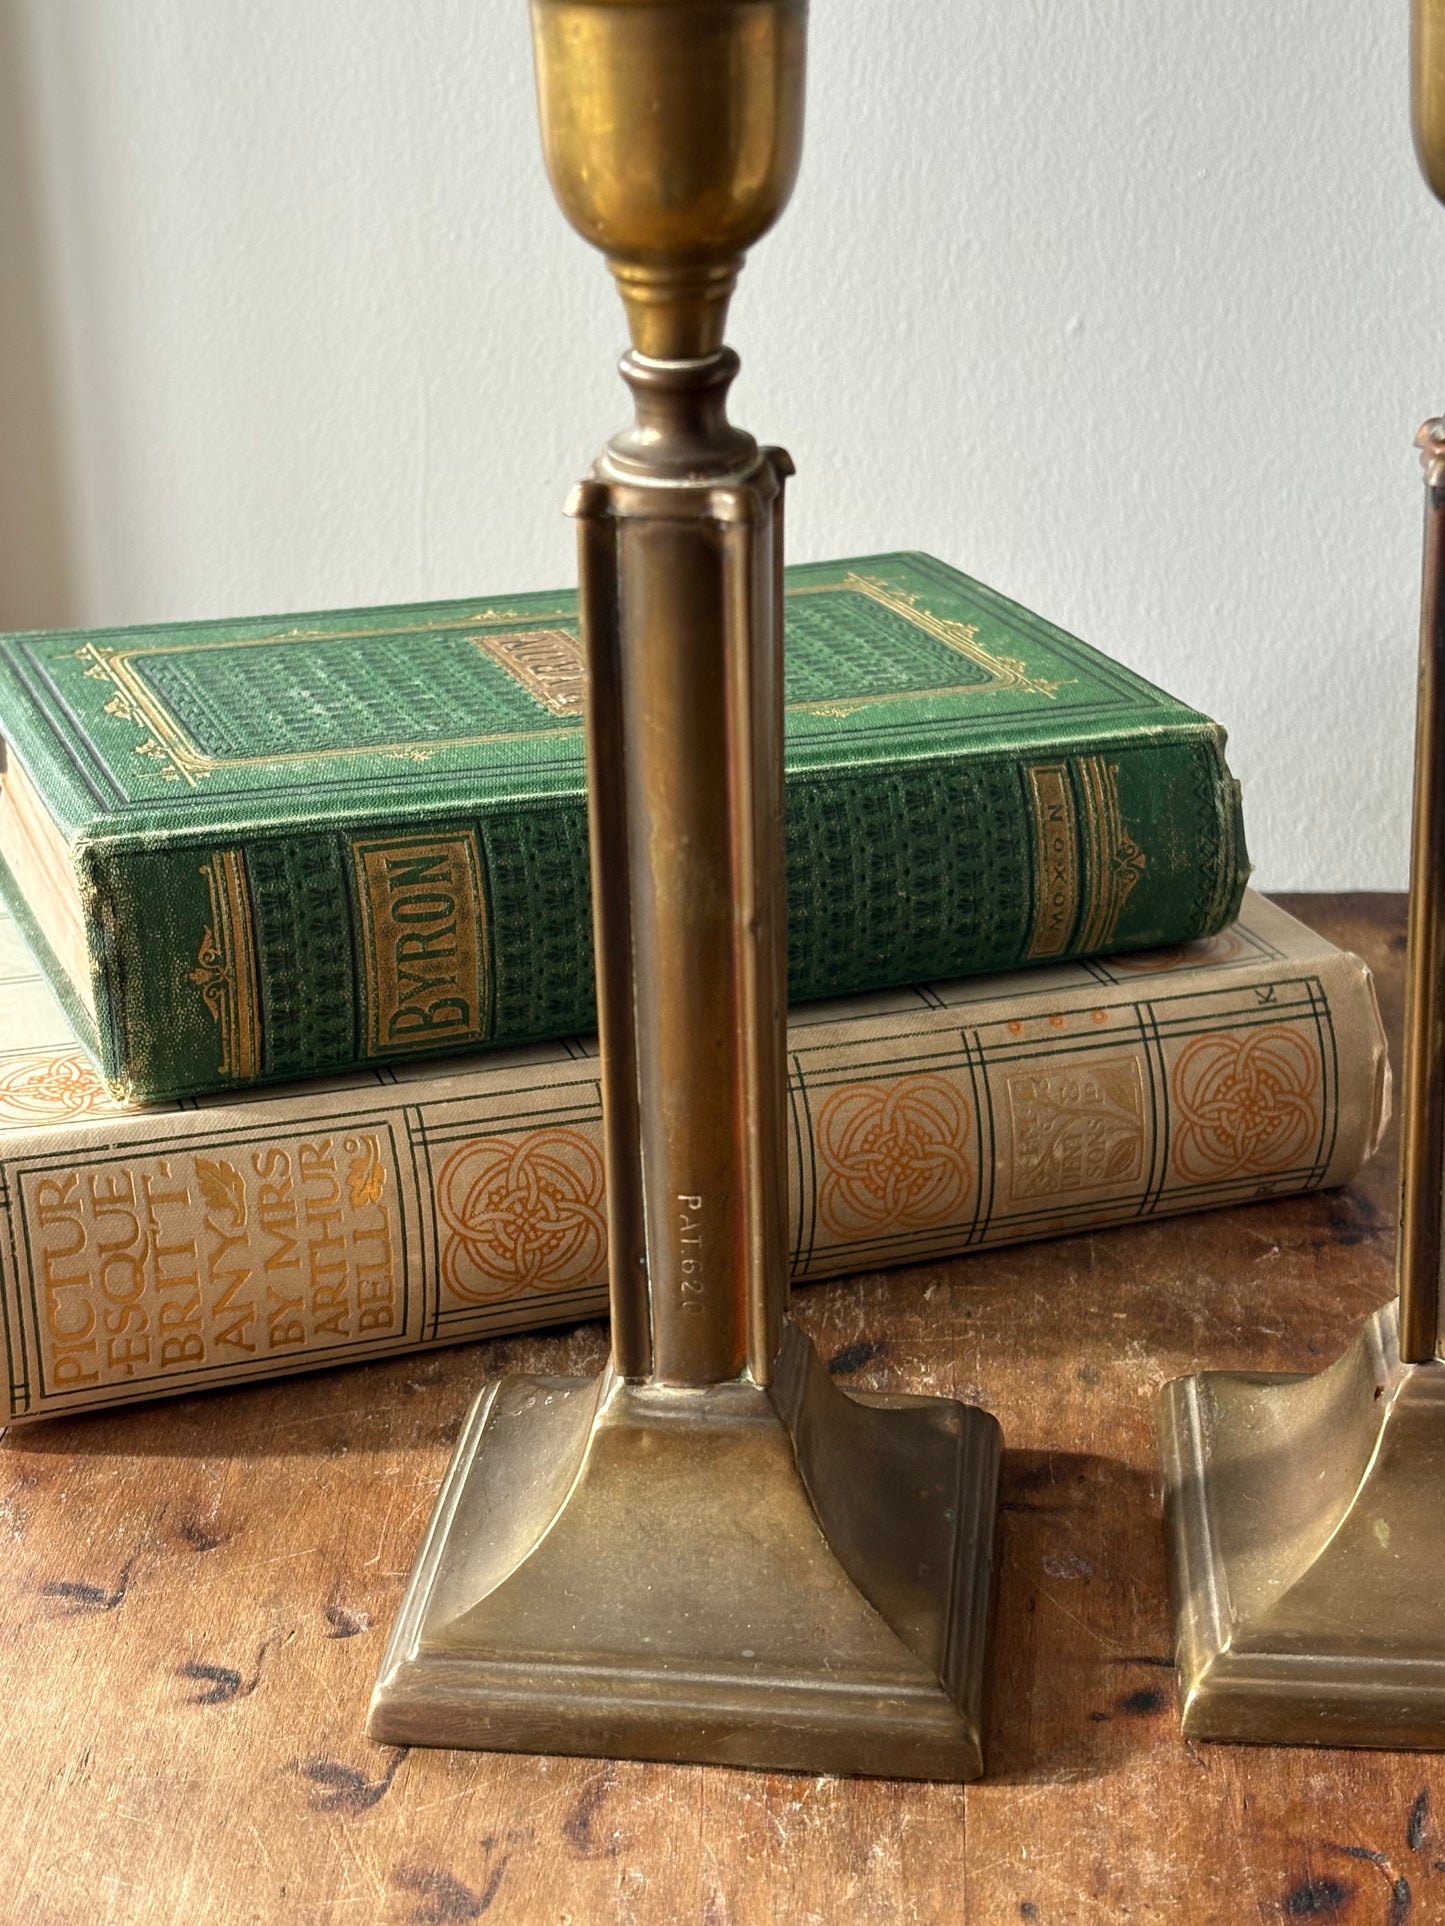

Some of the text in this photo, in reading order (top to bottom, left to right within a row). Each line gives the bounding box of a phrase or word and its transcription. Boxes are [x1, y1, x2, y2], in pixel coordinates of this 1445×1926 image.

[385, 853, 470, 1044] BYRON
[1047, 804, 1067, 933] MOXON
[1087, 1119, 1106, 1177] SONS
[34, 1172, 99, 1388] PICTUR
[203, 1217, 257, 1353] ANY
[252, 1148, 305, 1349] BY MRS
[300, 1137, 352, 1338] ARTHUR
[353, 1204, 395, 1334] BELL
